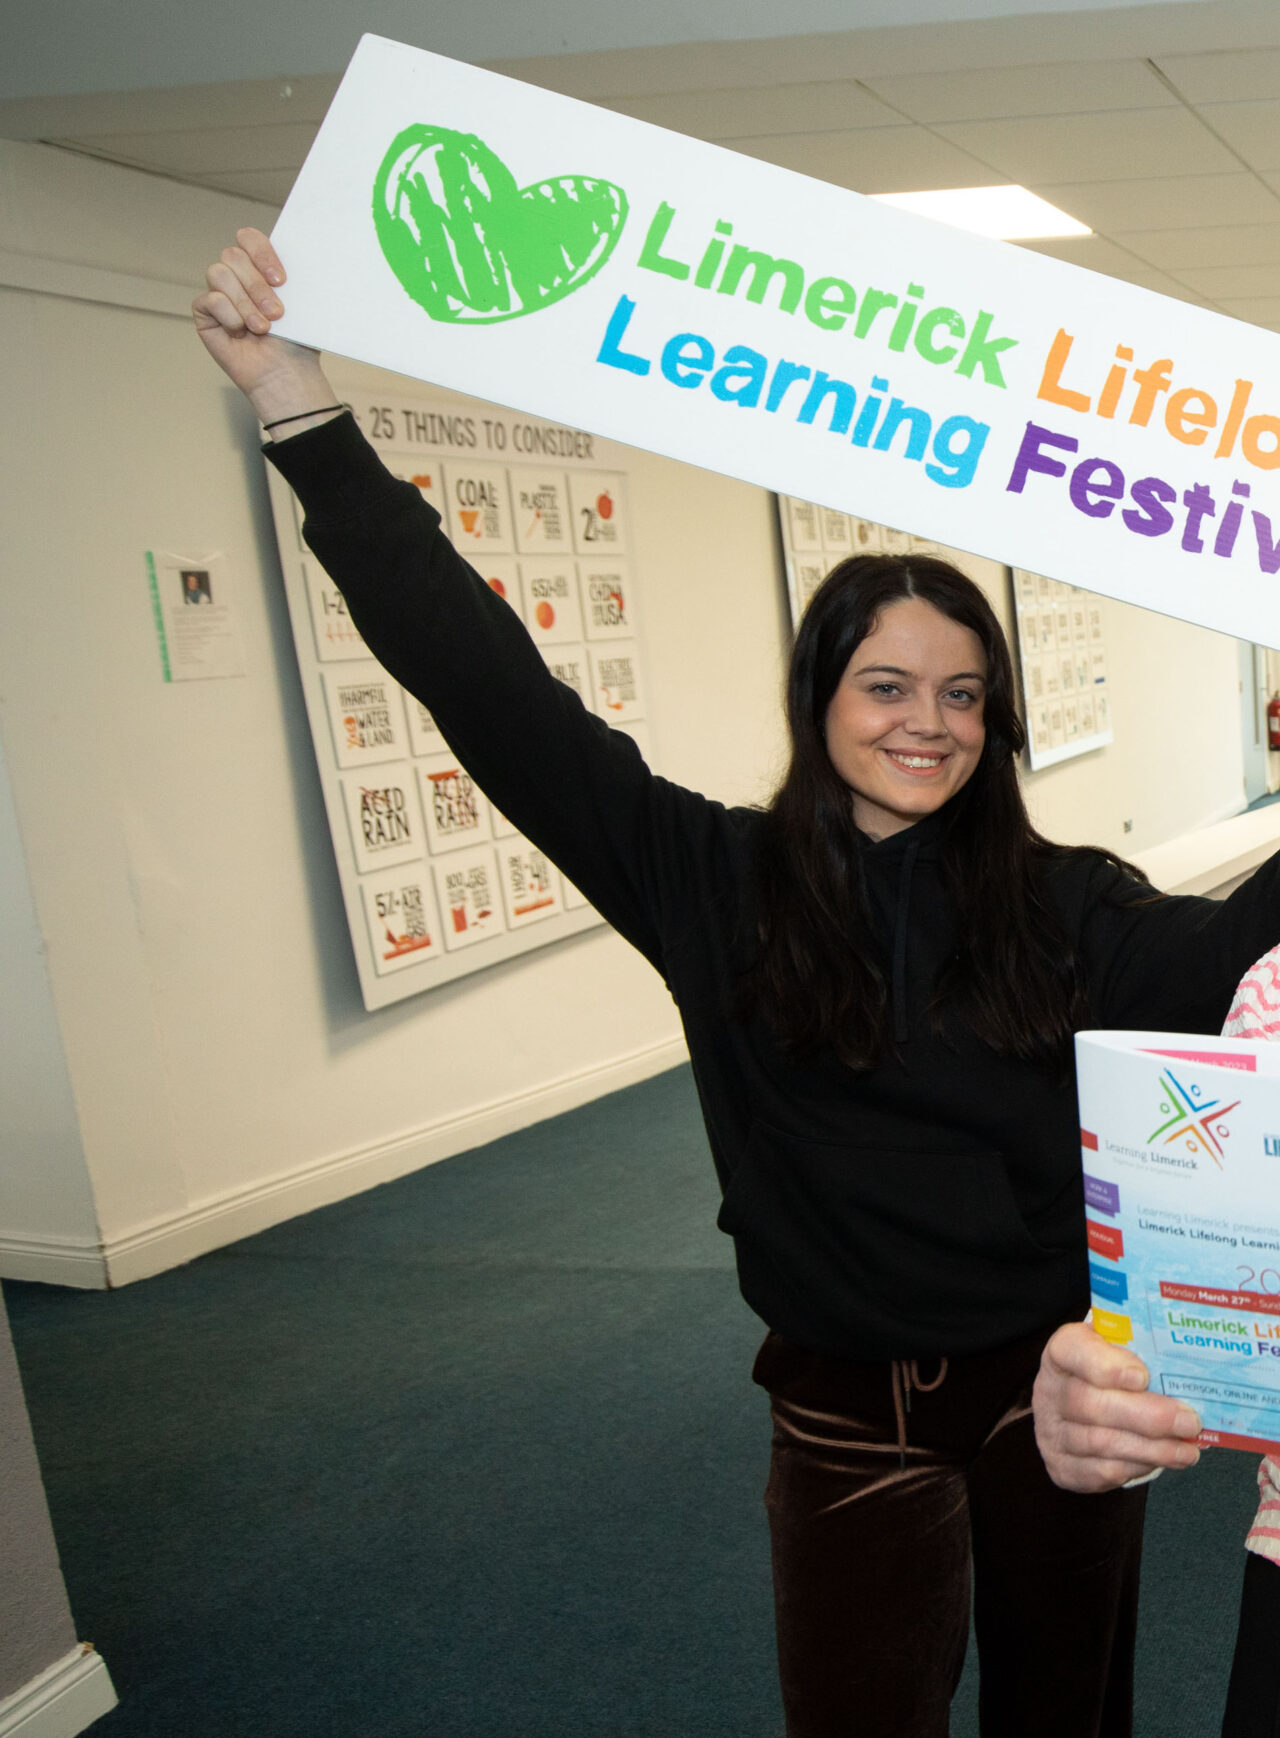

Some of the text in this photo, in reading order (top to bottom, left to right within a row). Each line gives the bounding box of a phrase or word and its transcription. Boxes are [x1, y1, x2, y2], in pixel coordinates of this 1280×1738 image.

[637, 201, 1018, 388] Limerick
[596, 294, 990, 488] Learning
[369, 406, 595, 459] 25 THINGS TO CONSIDER
[456, 478, 499, 508] COAL
[361, 787, 406, 816] ACID
[434, 774, 475, 801] ACID
[434, 797, 479, 830] RAIN
[361, 811, 411, 847] RAIN
[1105, 1140, 1147, 1162] Learning
[1150, 1152, 1198, 1170] Limerick
[1137, 1204, 1280, 1238] Learning Limerick presents
[1138, 1219, 1186, 1237] Limerick
[1190, 1228, 1237, 1247] Lifelong
[1162, 1285, 1197, 1301] Monday
[1198, 1290, 1229, 1304] March
[1167, 1311, 1249, 1337] Limerick
[1171, 1331, 1253, 1356] Learning
[1167, 1380, 1222, 1397] IN-PERSON,
[1223, 1388, 1257, 1402] ONLINE
[1261, 1395, 1280, 1407] AND
